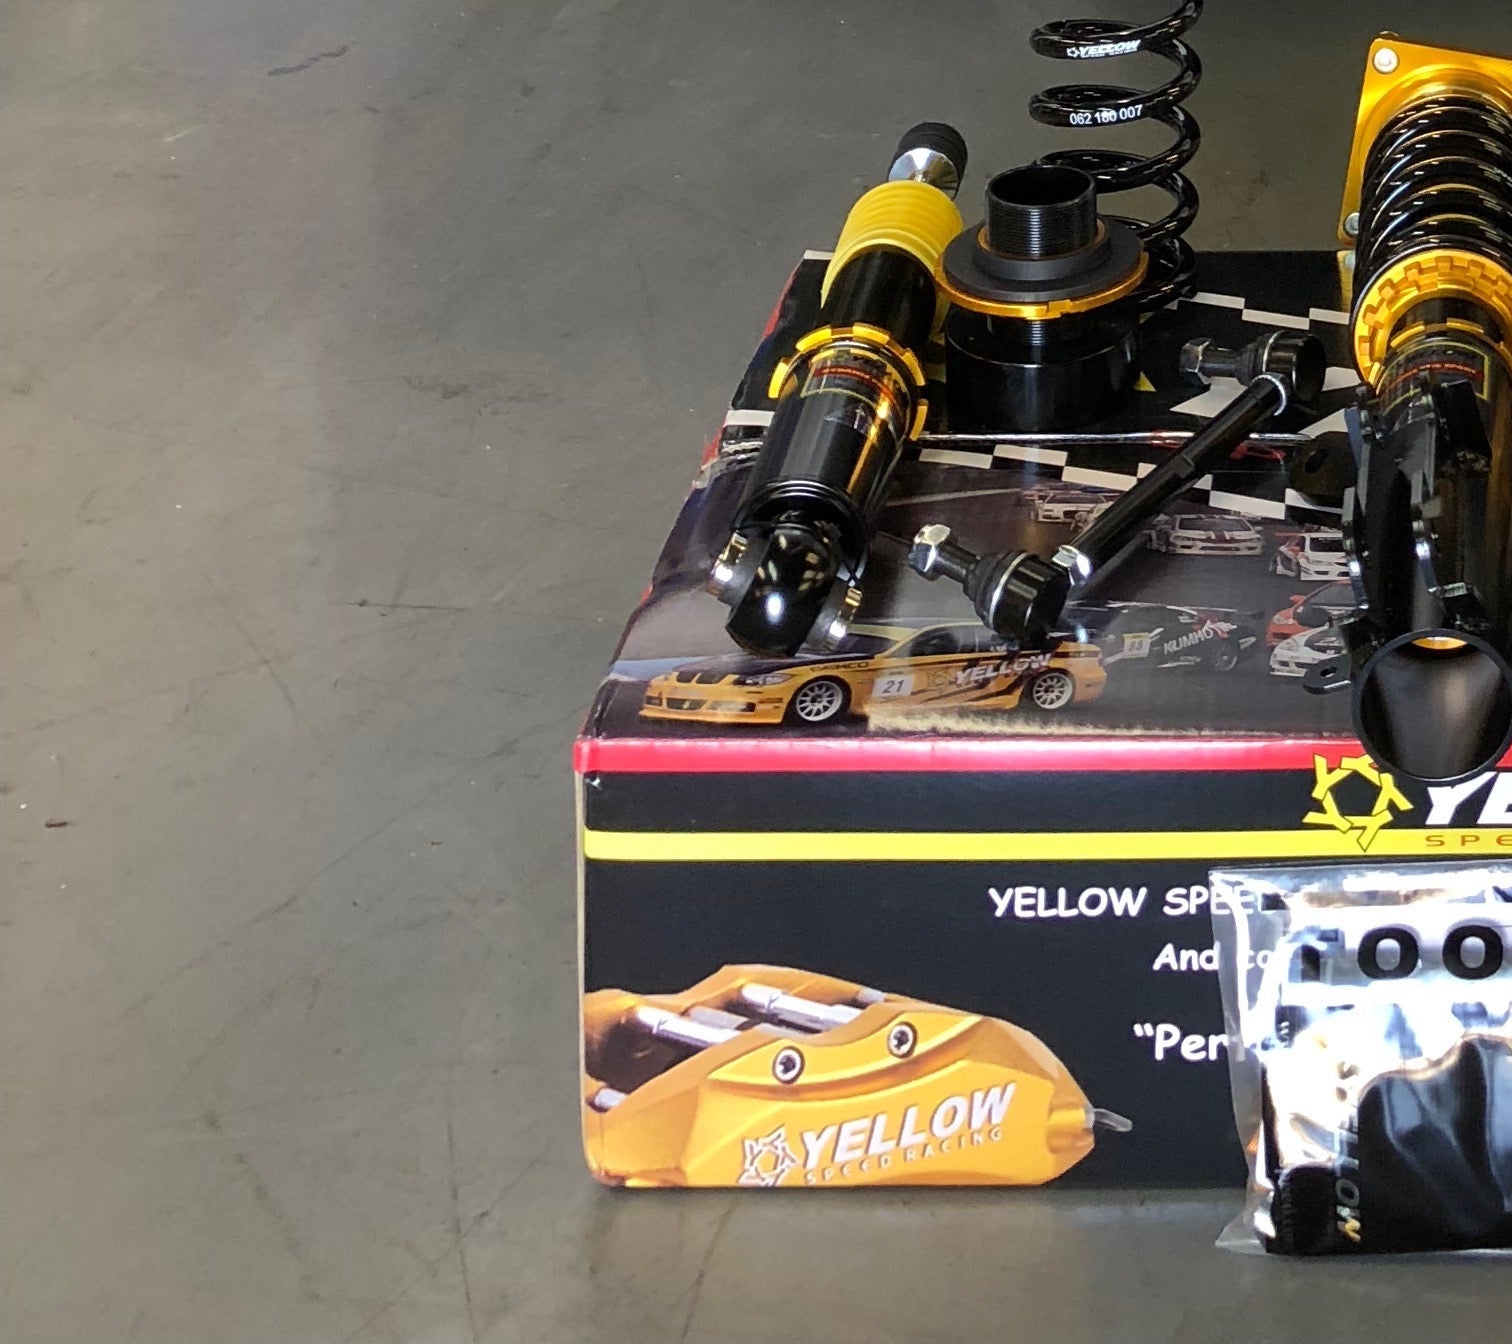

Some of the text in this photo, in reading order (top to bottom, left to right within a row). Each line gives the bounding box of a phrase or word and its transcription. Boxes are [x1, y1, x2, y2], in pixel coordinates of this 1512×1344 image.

[1069, 104, 1143, 125] 062 180 007
[955, 653, 1051, 684] YELLOW
[881, 679, 905, 694] 21
[988, 886, 1148, 918] YELLOW
[1153, 942, 1221, 971] And
[801, 1082, 1017, 1170] YELLOW
[803, 1127, 1003, 1186] SPEED RACING
